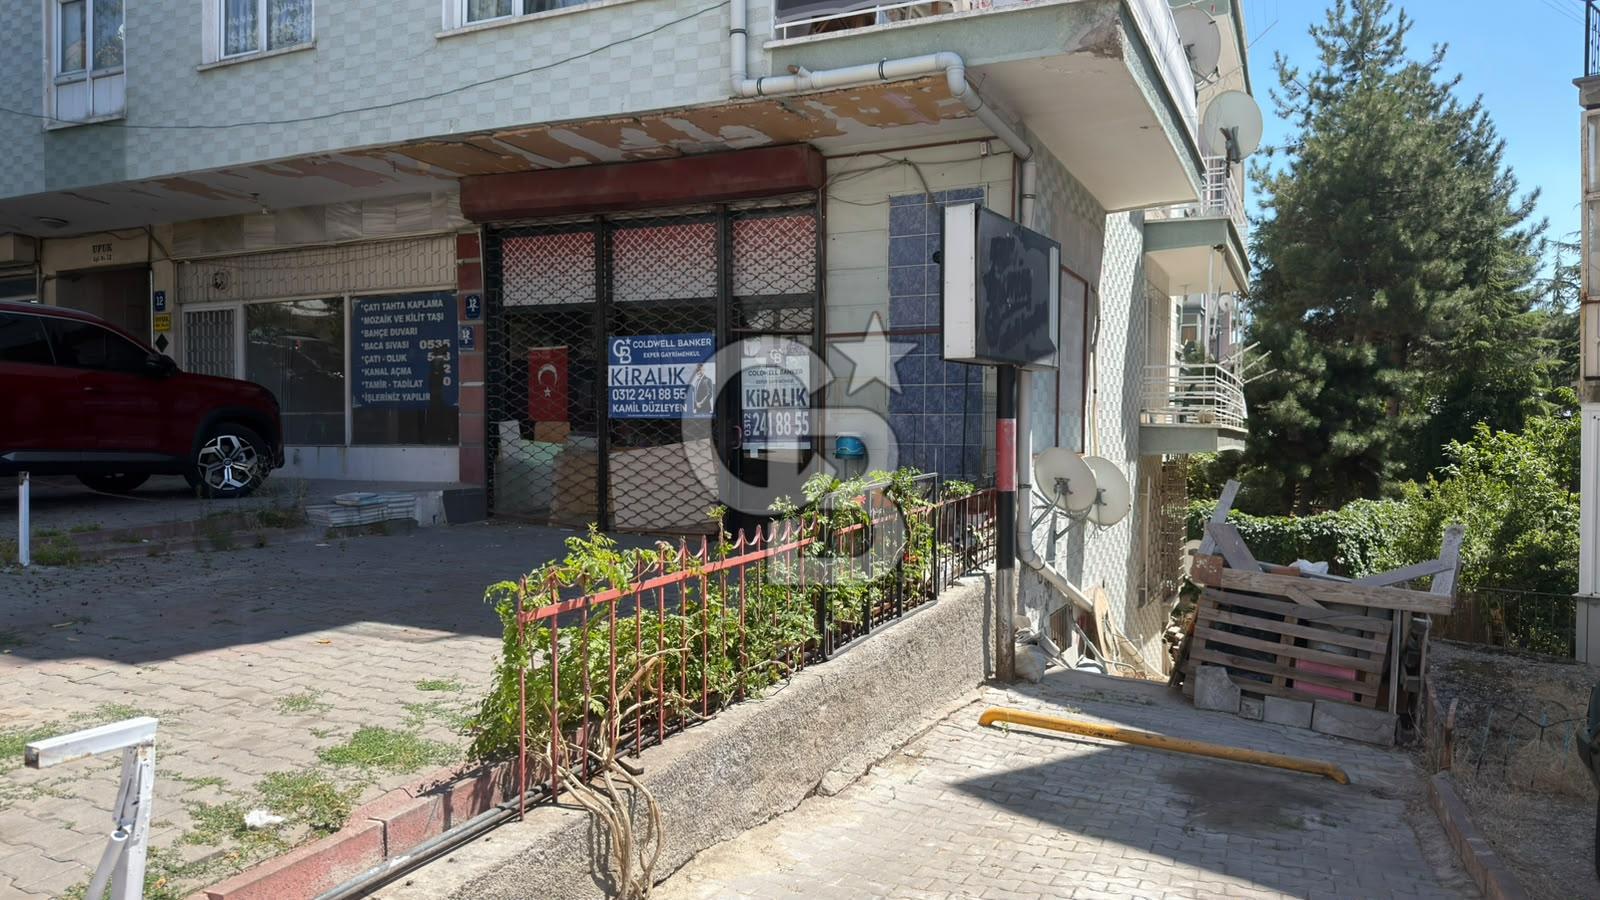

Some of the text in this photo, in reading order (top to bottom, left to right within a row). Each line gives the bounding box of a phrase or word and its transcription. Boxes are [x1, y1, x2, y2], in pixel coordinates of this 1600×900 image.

[155, 296, 164, 306] 12
[364, 299, 443, 312] ÇATI TAHTA KAPLAMA
[469, 298, 477, 308] 12
[364, 312, 444, 325] MOZAİK VE KİLİT TAŞI
[364, 328, 417, 338] BAHÇE DUVARI
[462, 329, 470, 339] 12
[385, 341, 409, 349] SIVASI
[419, 339, 450, 350] 0535
[633, 338, 712, 349] COLDWELL BANKER
[364, 355, 380, 365] ÇATI
[387, 354, 407, 362] OLUK
[364, 367, 412, 376] KANAL AÇMA
[611, 366, 685, 385] KİRALIK
[365, 379, 387, 388] TAMİR
[393, 378, 423, 388] TADİLAT
[365, 392, 430, 404] İŞLERİNİZ YAPILIR
[612, 388, 688, 400] 0312 241 88 55
[612, 401, 687, 413] KAMİL DÜZLEYEN
[743, 413, 751, 436] 0312
[752, 411, 809, 436] 241 88 55
